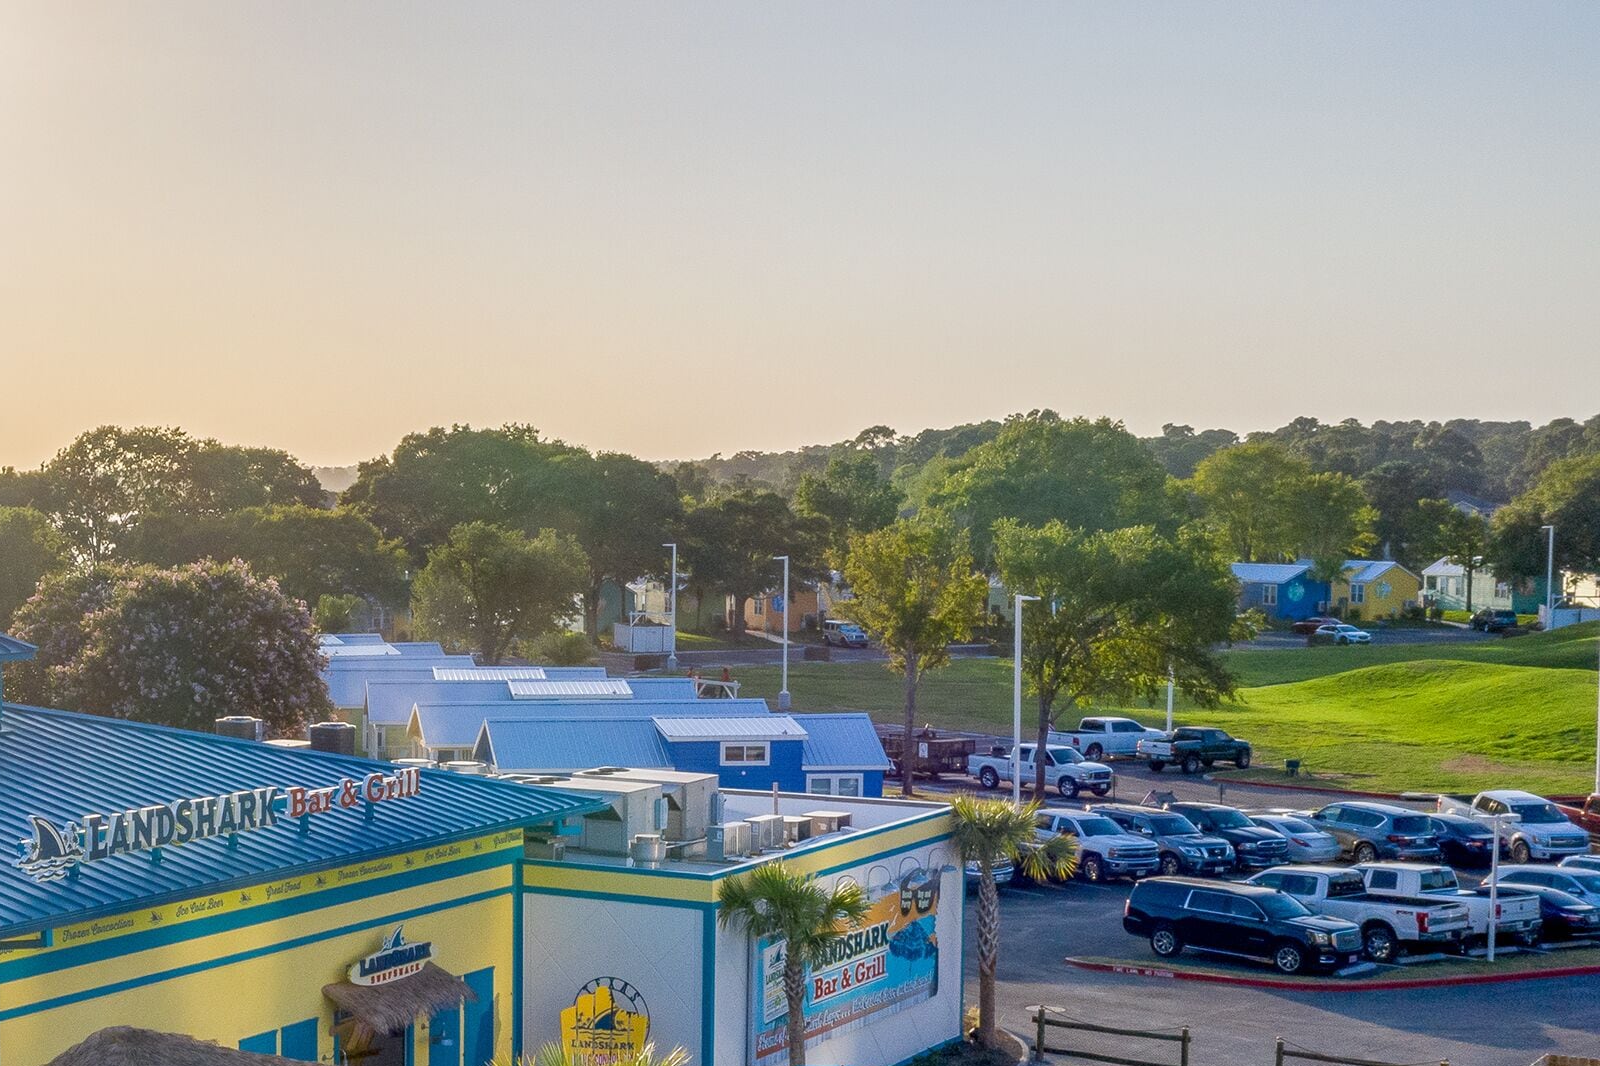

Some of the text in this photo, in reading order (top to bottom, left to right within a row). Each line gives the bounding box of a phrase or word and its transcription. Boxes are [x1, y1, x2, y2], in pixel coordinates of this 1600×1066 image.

[83, 767, 421, 861] LANDSHARK Bar & Grill
[62, 919, 135, 942] Frozen Concoctions
[370, 963, 420, 984] SURFSHACK
[813, 976, 838, 1001] Bar
[841, 967, 852, 990] &
[854, 954, 885, 984] Grill
[571, 1039, 635, 1051] LANDSHARK
